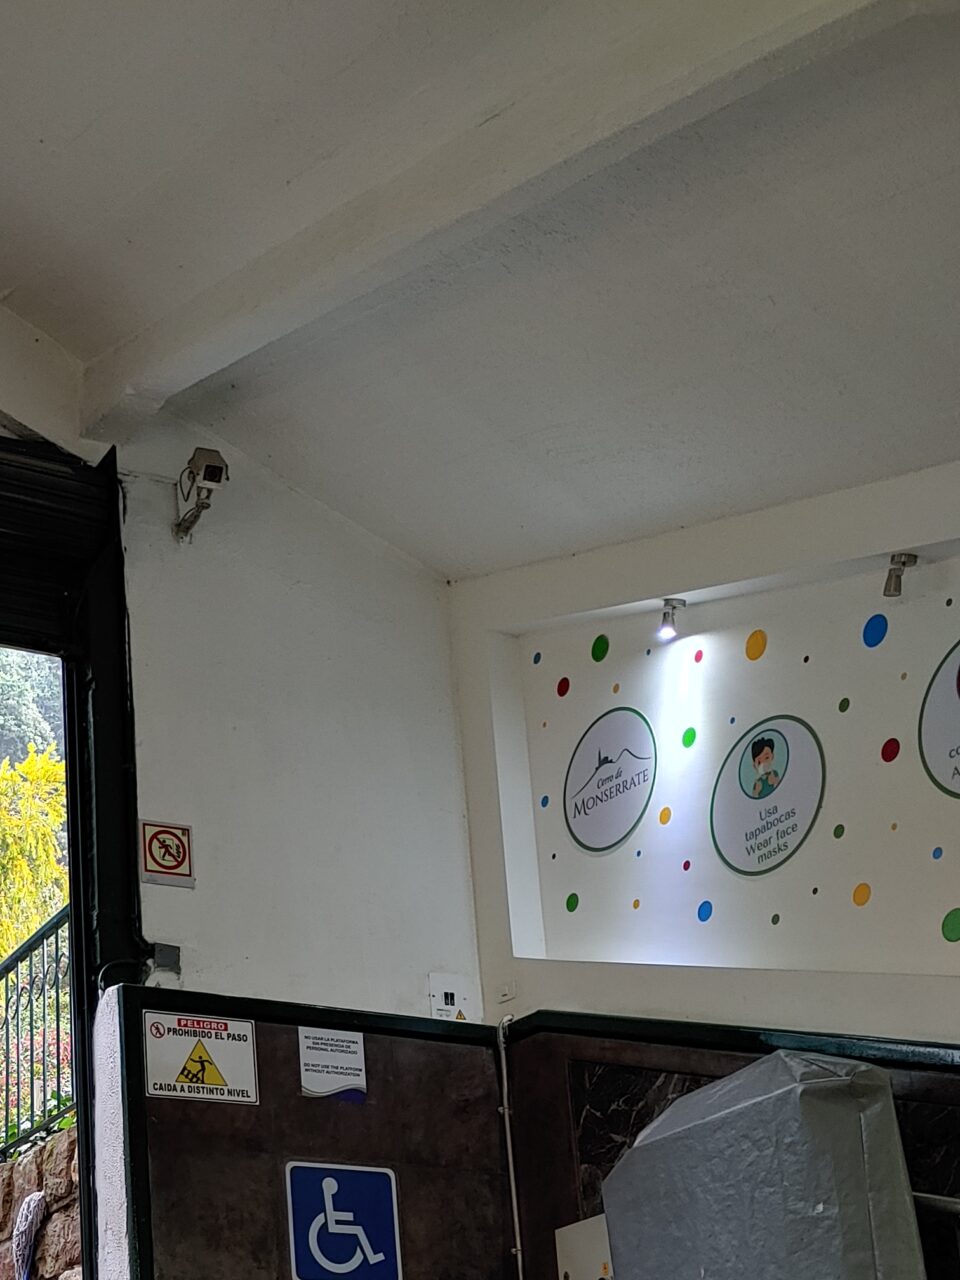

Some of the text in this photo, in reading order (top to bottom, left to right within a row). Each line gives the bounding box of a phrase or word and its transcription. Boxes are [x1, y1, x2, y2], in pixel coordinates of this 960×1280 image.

[597, 767, 622, 789] Cerro de
[573, 769, 648, 819] MONSERRATE
[759, 805, 777, 821] Usa
[745, 808, 796, 841] tapabocas
[745, 823, 798, 856] Wear face
[758, 842, 789, 864] masks
[167, 1027, 248, 1042] PROHIBIDO EL PASO
[181, 1020, 225, 1030] PELIGRO
[153, 1082, 251, 1098] CAIDA A DISTINTO NIVEL
